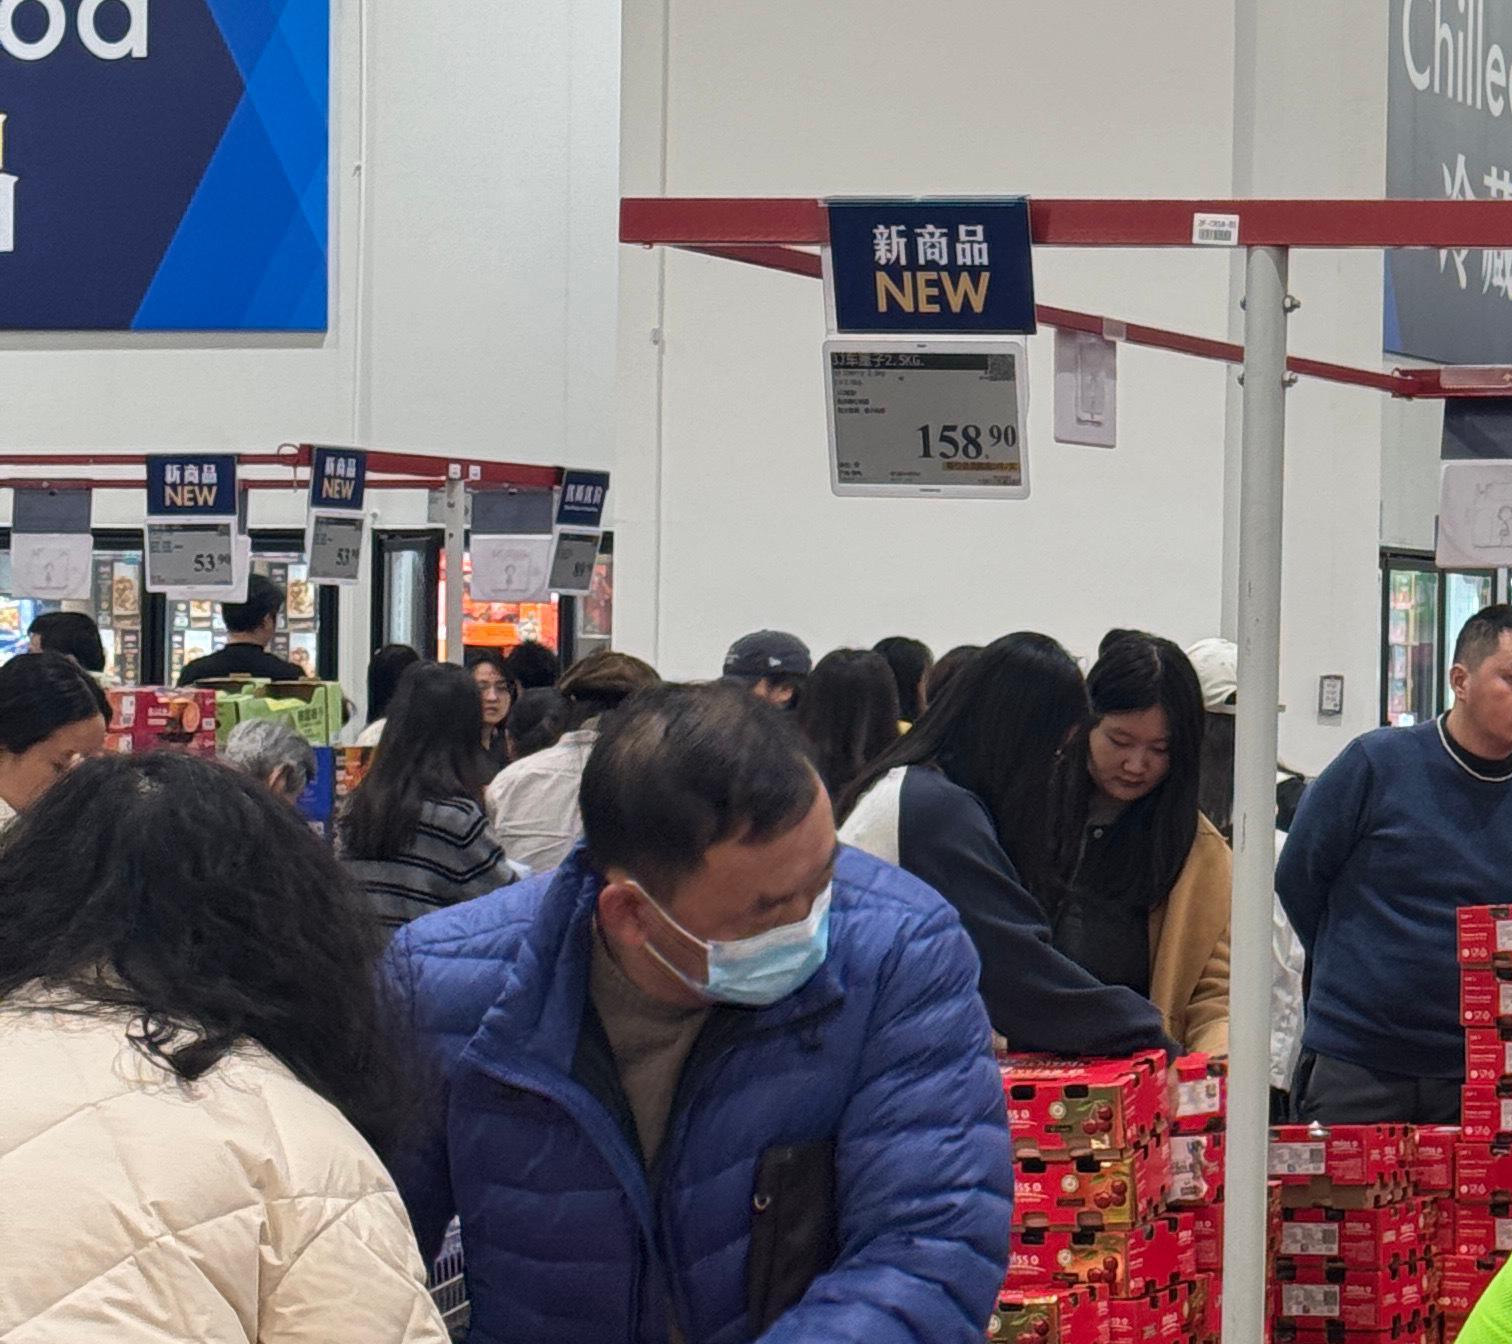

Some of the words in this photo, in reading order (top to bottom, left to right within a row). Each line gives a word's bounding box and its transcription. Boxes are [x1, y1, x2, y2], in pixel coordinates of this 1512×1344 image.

[873, 224, 989, 266] 新商品
[875, 271, 990, 314] NEW
[916, 424, 1017, 460] 158.90
[165, 464, 217, 484] 新商品
[322, 477, 355, 500] NEW
[164, 485, 218, 507] NEW
